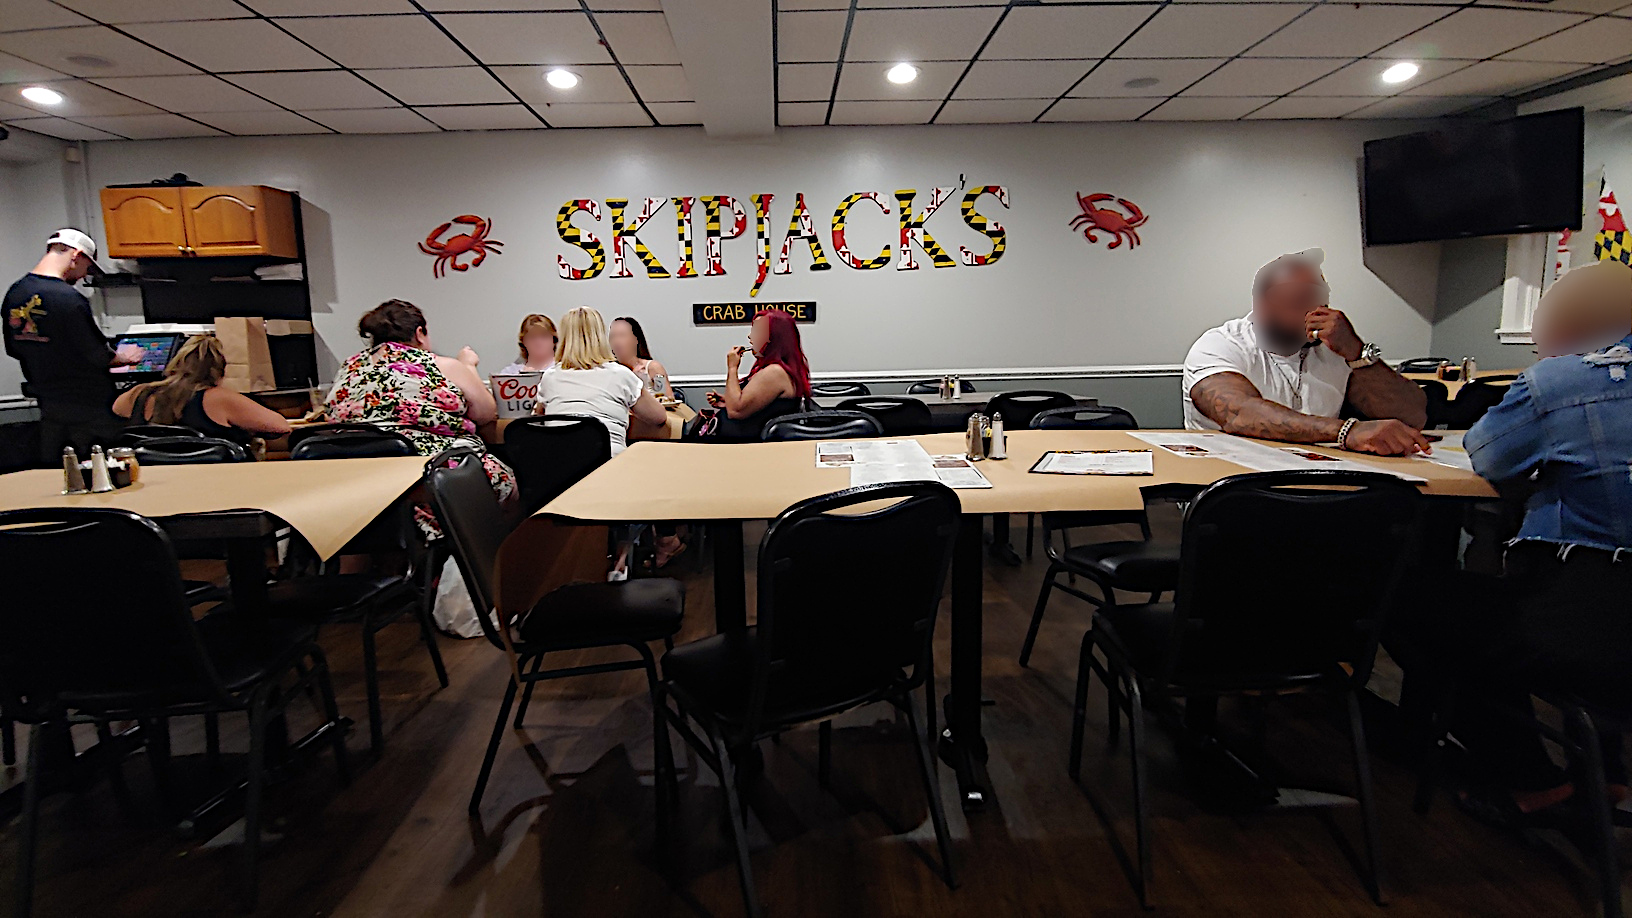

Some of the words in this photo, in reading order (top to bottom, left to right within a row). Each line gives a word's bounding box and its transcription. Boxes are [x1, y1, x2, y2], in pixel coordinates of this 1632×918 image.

[556, 173, 1010, 298] SKIPJACK'S
[703, 304, 746, 320] CRAB
[498, 378, 538, 400] Coo
[507, 400, 536, 411] LIG
